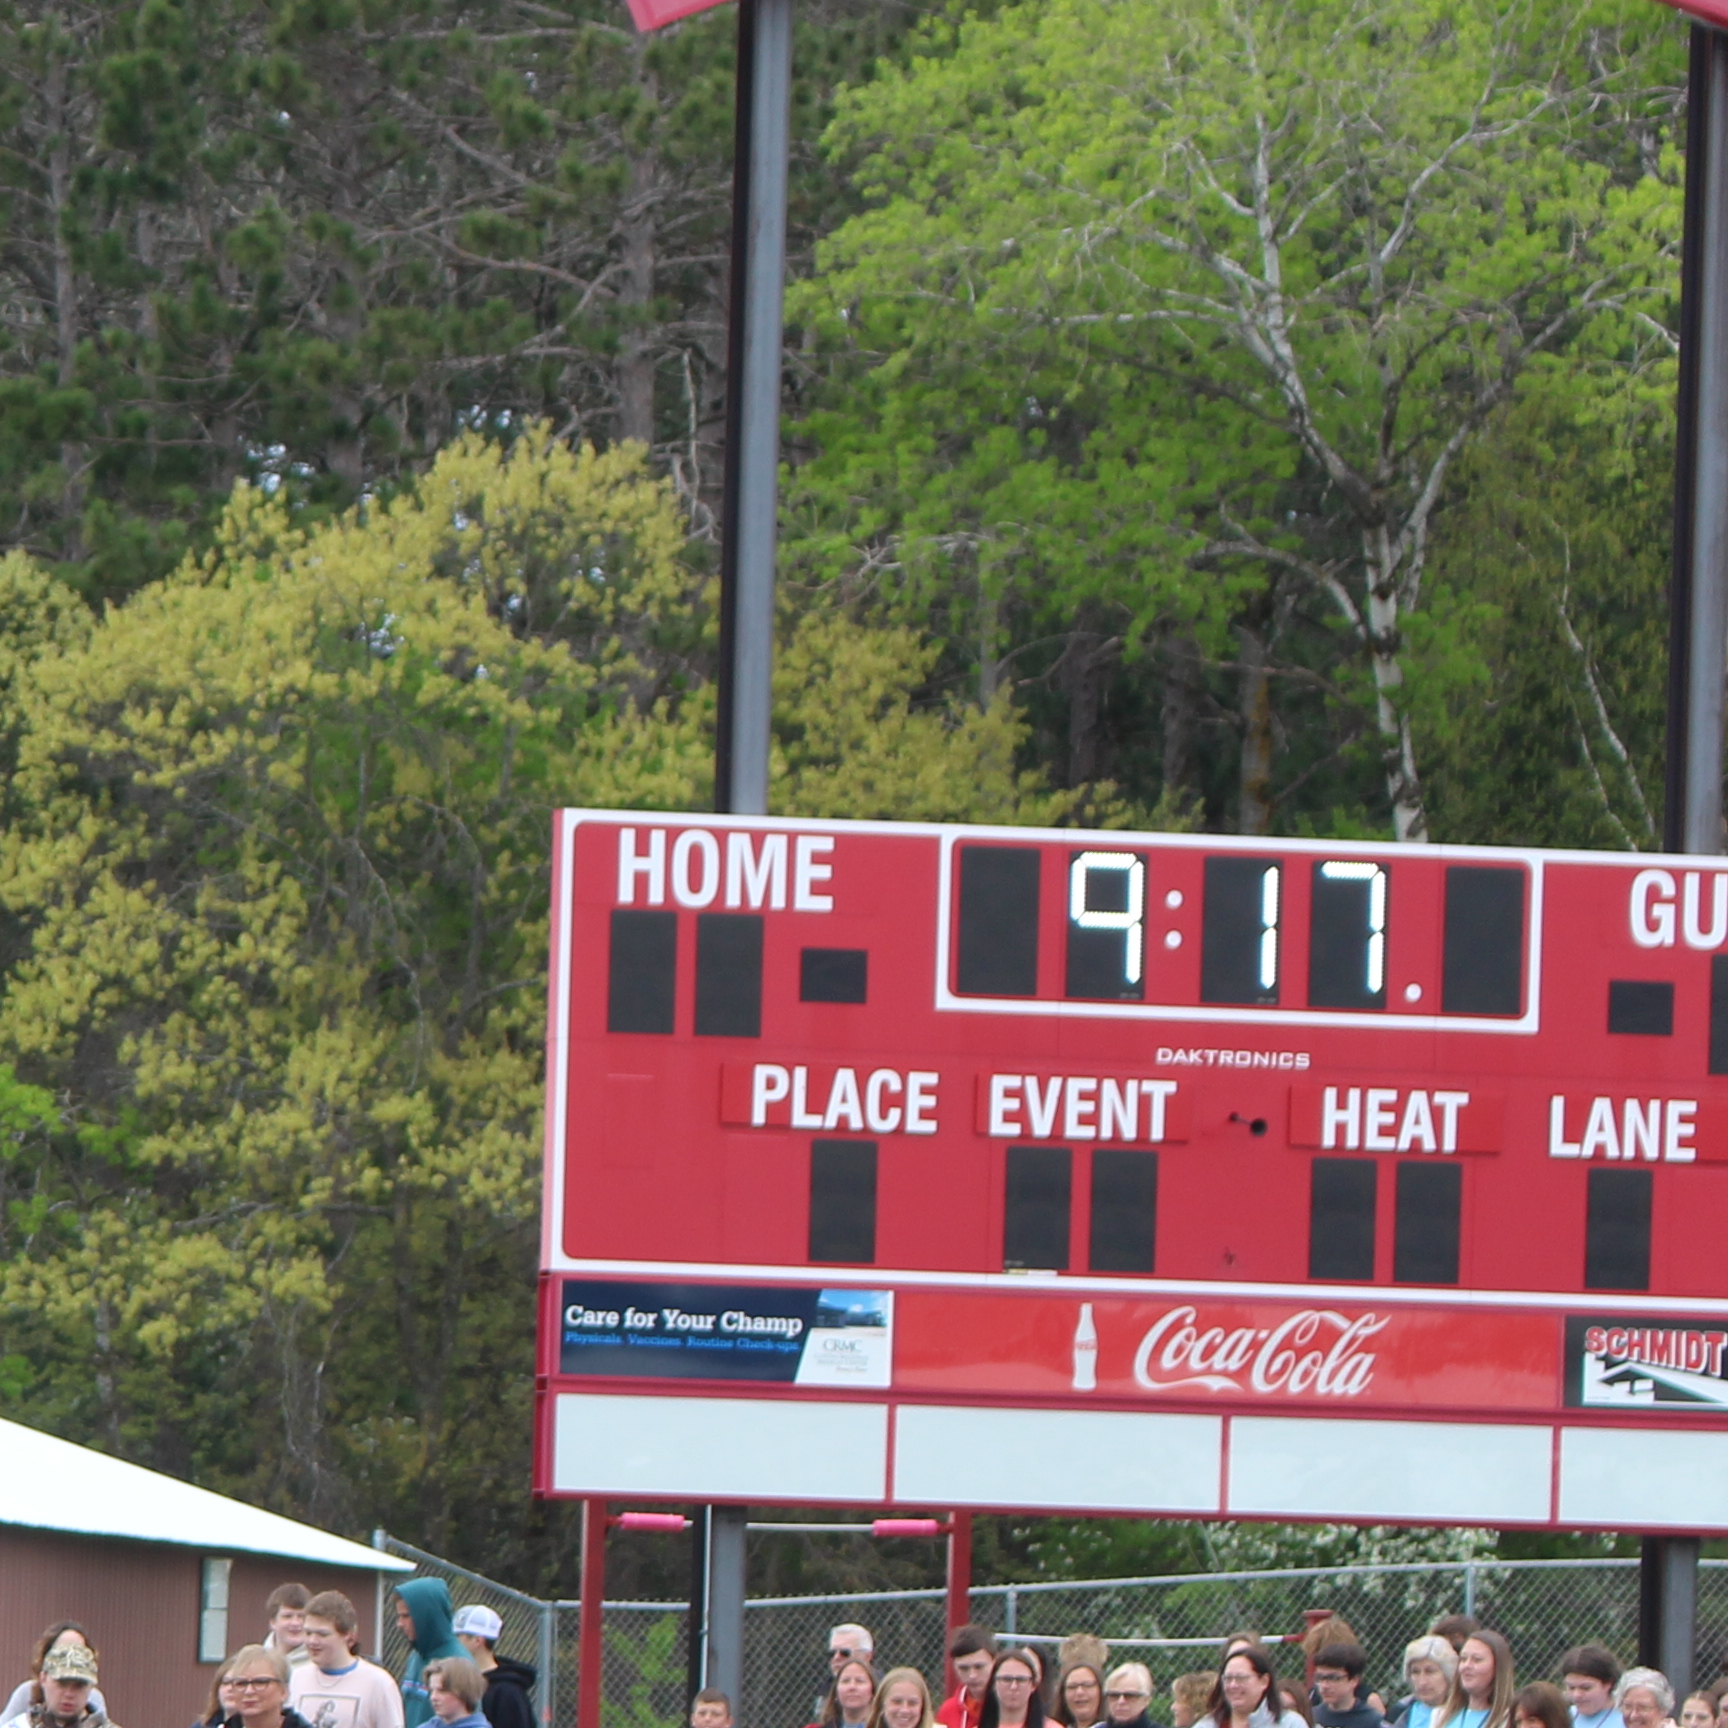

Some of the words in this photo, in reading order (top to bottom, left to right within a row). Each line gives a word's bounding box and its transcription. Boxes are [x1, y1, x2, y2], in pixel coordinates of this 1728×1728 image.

[617, 827, 834, 912] HOME
[1155, 1047, 1311, 1070] DAKTRONICS
[751, 1063, 940, 1135] PLACE
[989, 1074, 1177, 1143] EVENT
[1321, 1086, 1469, 1153] HEAT
[1549, 1094, 1698, 1162] LANE
[565, 1304, 620, 1328] Care
[623, 1306, 658, 1328] for
[662, 1309, 716, 1332] Your
[720, 1310, 803, 1338] Champ
[1134, 1306, 1391, 1396] Coca-Cola
[1586, 1326, 1727, 1377] SCHMIDT
